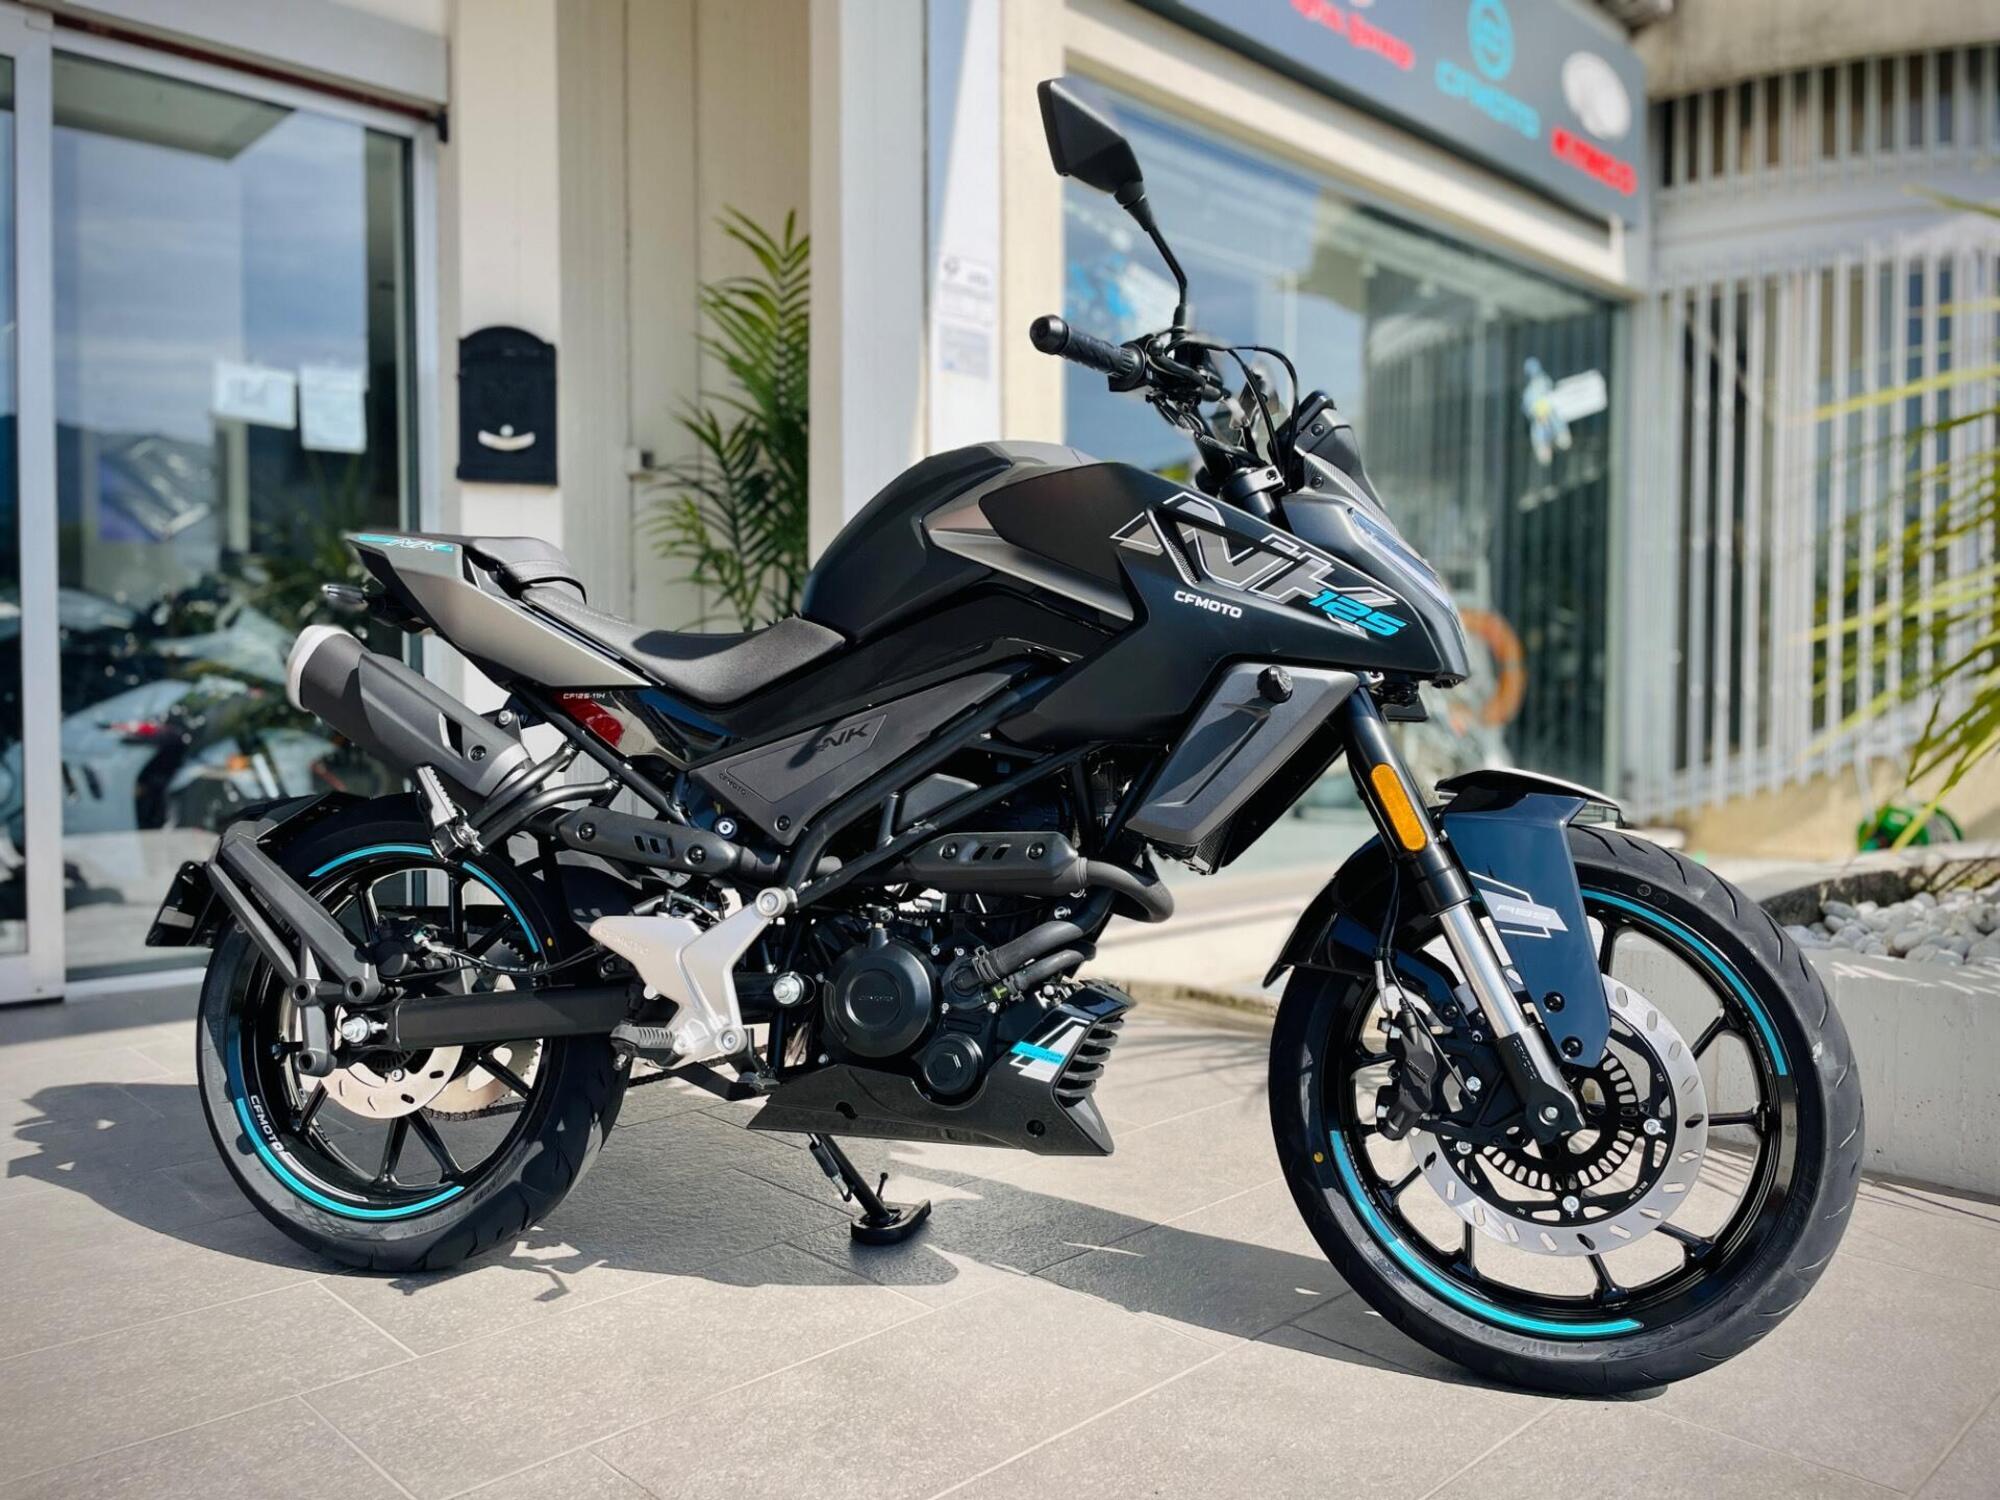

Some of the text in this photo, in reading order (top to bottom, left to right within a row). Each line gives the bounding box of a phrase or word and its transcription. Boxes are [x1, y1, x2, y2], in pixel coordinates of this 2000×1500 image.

[1174, 590, 1243, 618] CFMOTO
[1308, 590, 1407, 637] 125
[250, 1094, 285, 1153] CFMOTO
